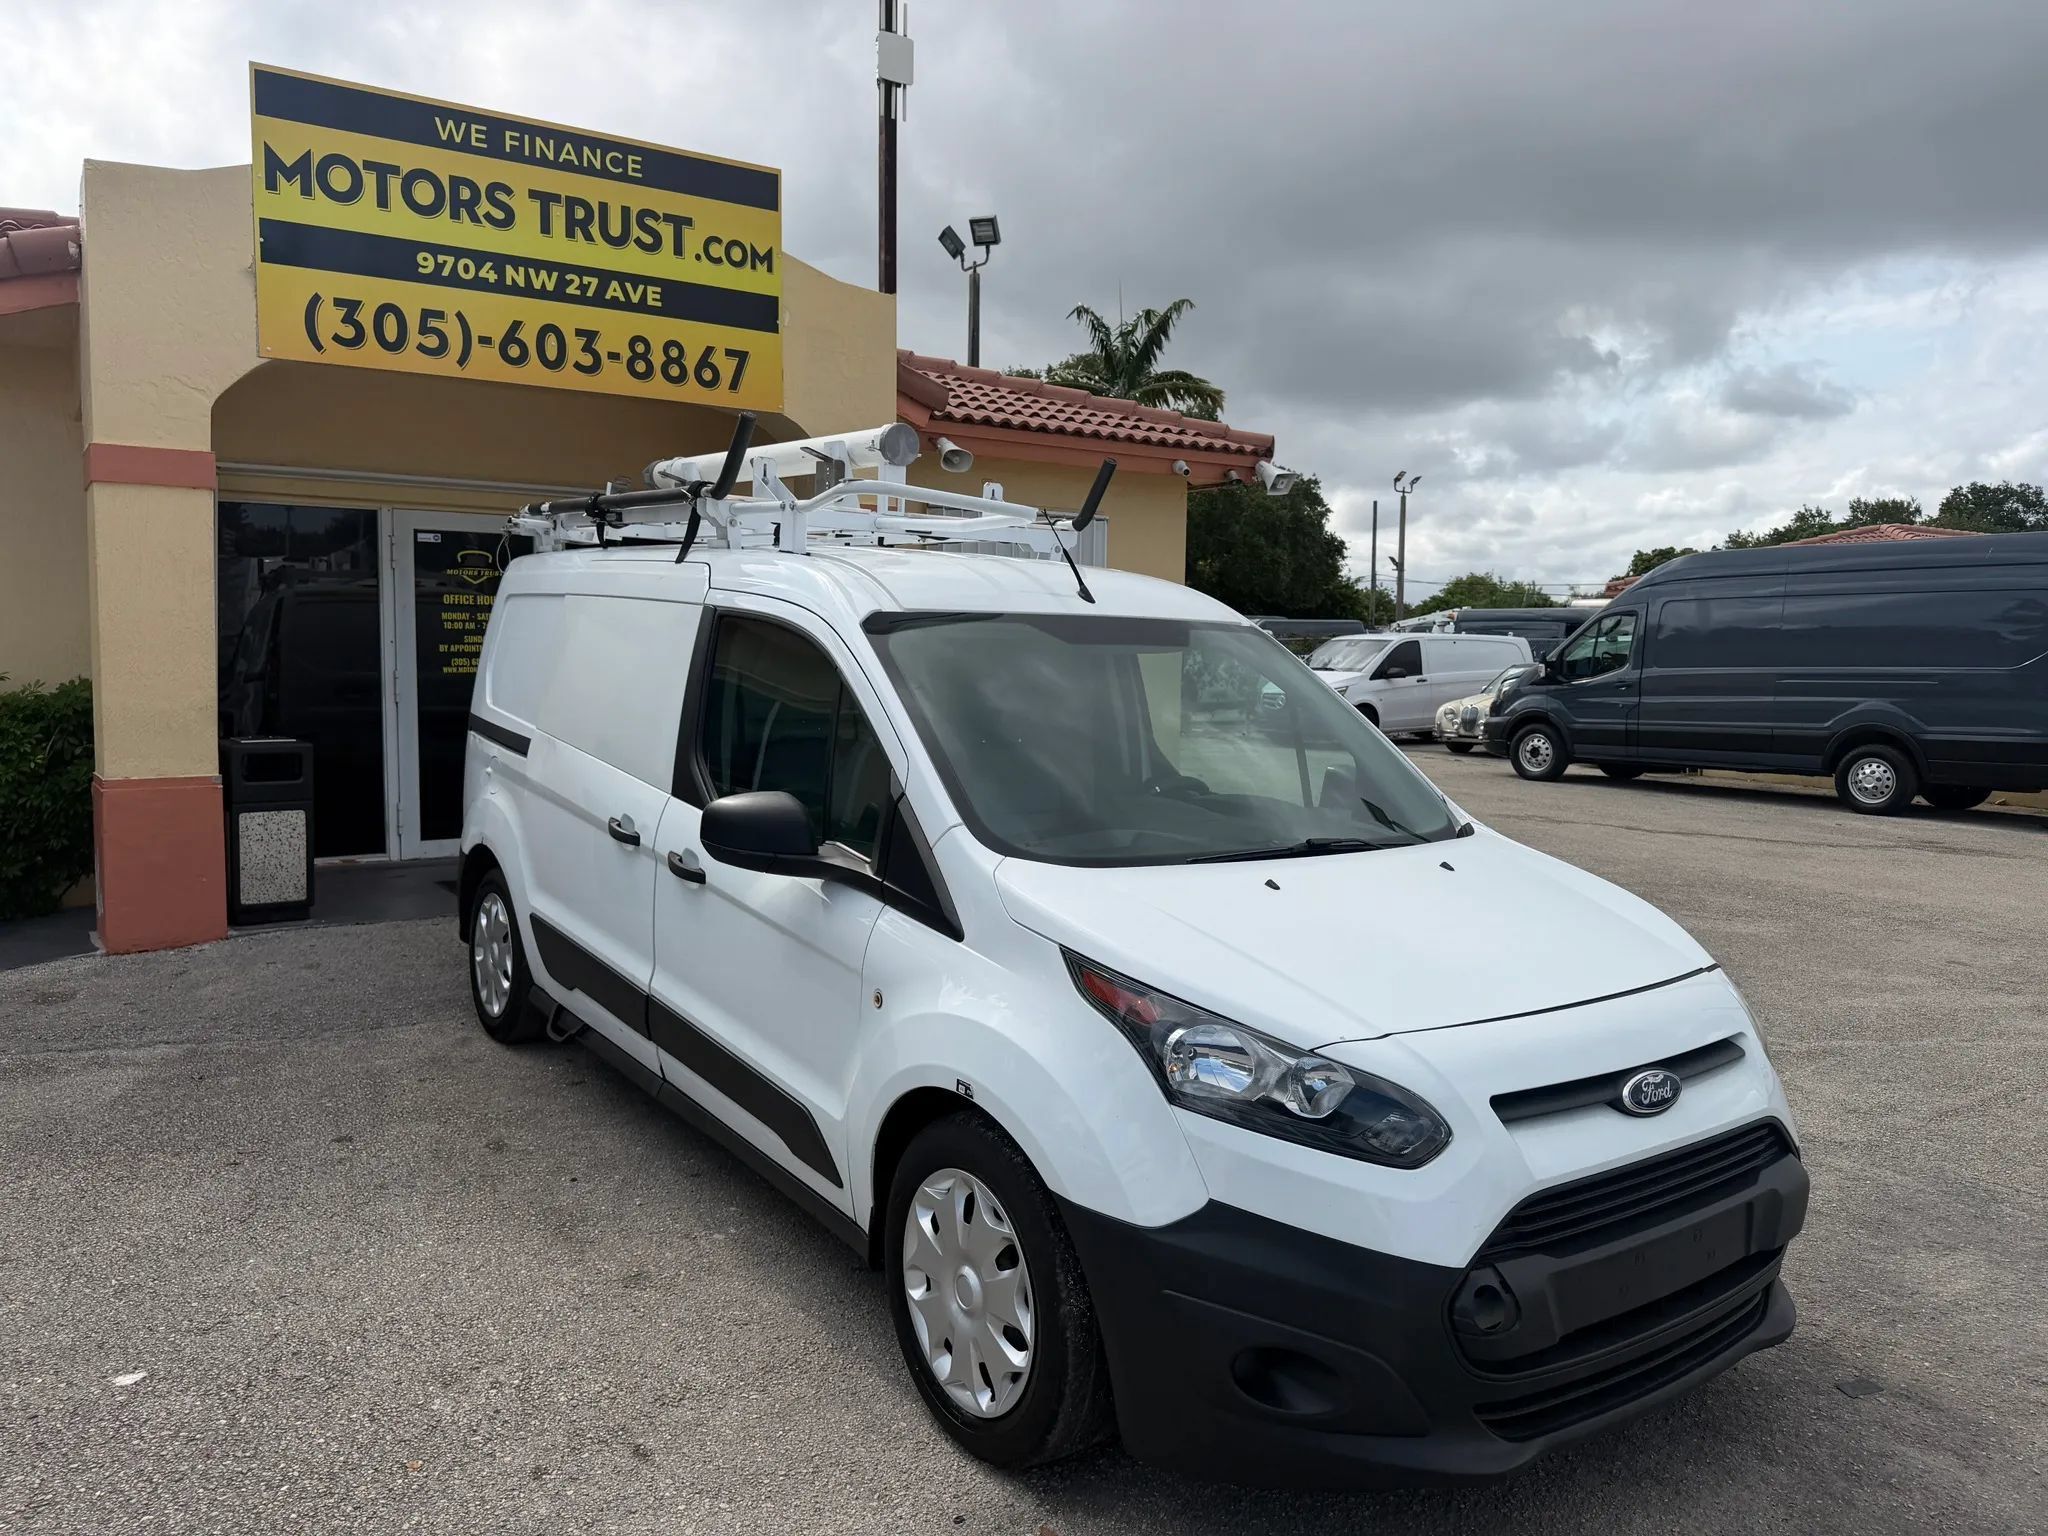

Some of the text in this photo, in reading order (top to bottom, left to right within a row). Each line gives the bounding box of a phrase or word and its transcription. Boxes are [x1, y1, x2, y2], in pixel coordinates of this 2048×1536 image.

[434, 116, 644, 178] WE FINANCE
[263, 140, 775, 275] MOTORS TRUST.COM
[416, 251, 663, 307] 9704 NW 27 AVE
[304, 291, 751, 394] (305)-603-8867
[446, 568, 478, 577] MOTORS
[443, 594, 475, 605] OFFICE
[441, 612, 470, 621] MONDAY
[443, 621, 463, 630] 10:00
[464, 622, 476, 630] AM
[464, 635, 483, 643] SUND
[439, 644, 448, 652] BY
[1641, 1074, 1673, 1105] Ford
